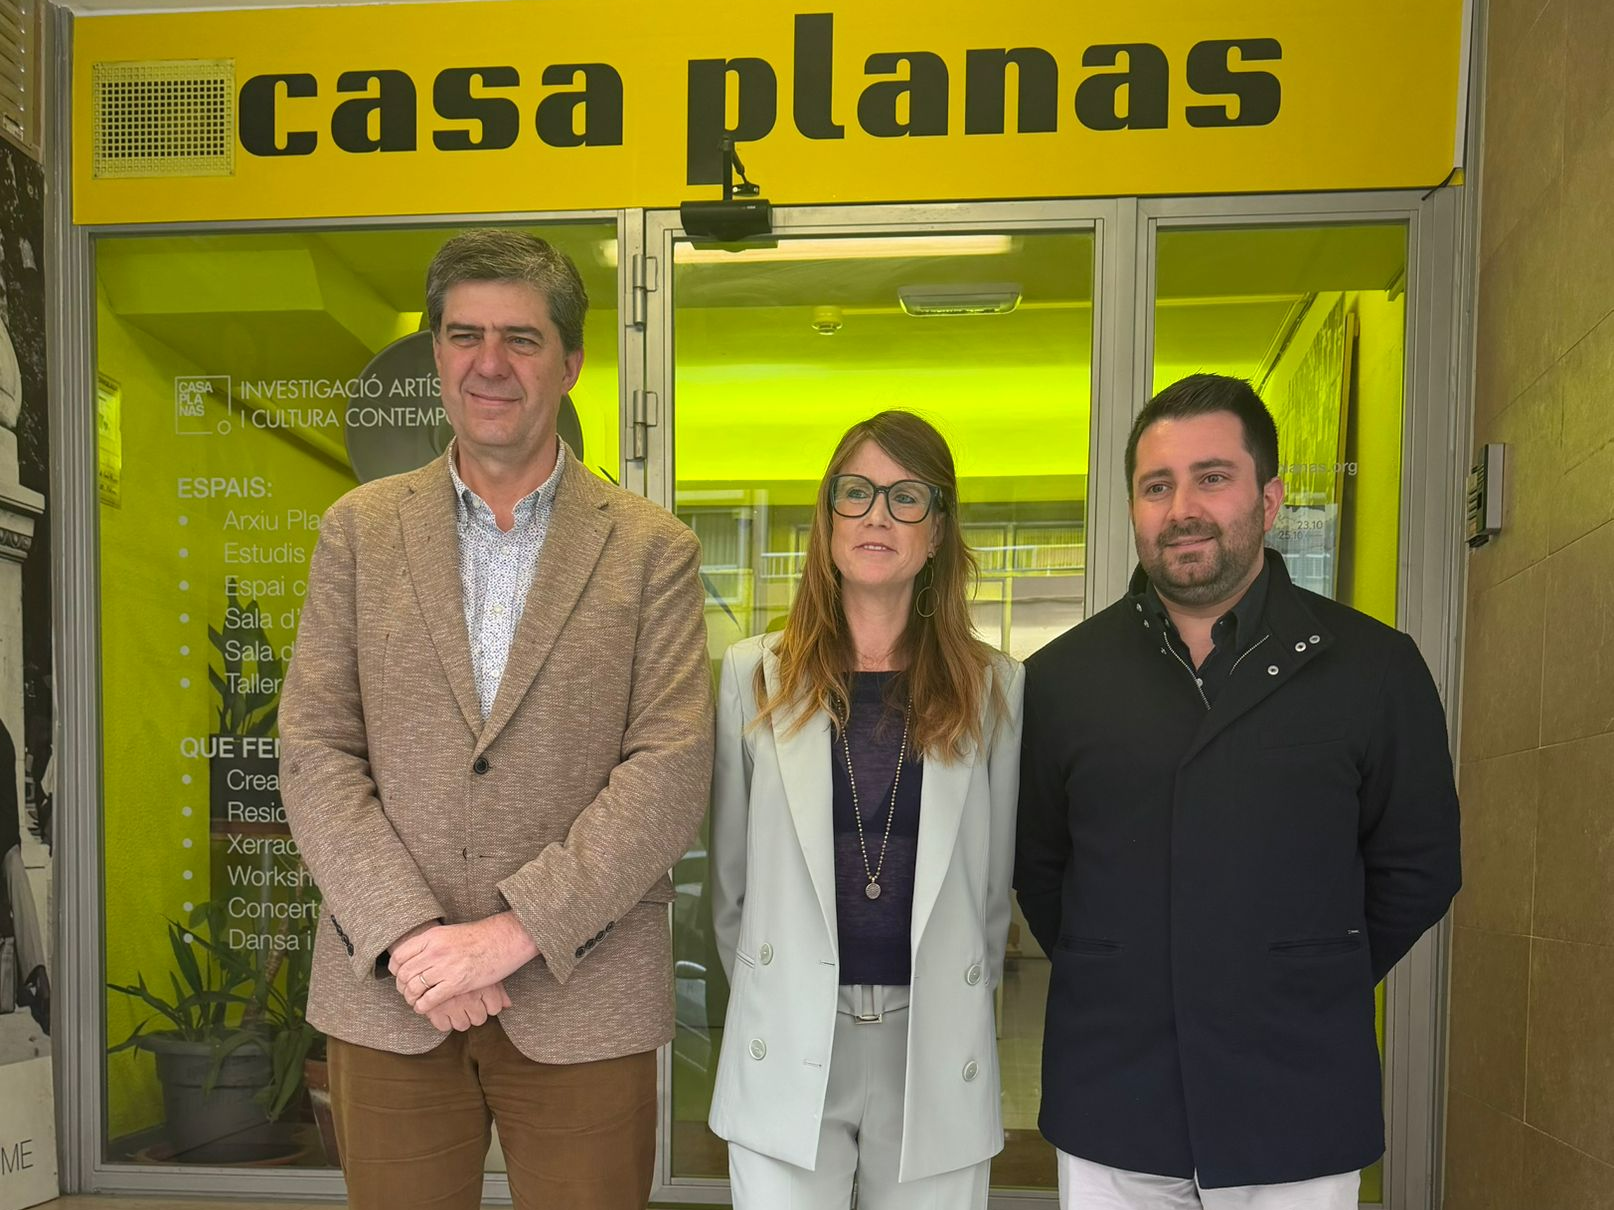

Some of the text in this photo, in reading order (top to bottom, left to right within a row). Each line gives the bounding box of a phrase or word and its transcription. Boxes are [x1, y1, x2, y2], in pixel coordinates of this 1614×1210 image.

[238, 12, 1283, 186] casa planas
[179, 381, 213, 393] CASA
[241, 372, 441, 399] INVESTIGACIÓ ARTÍS
[179, 393, 204, 405] PLA
[179, 405, 205, 416] NAS
[251, 408, 340, 429] CULTURA
[345, 407, 452, 428] CONTEMP
[177, 476, 273, 499] ESPAIS:
[223, 508, 321, 531] Arxiu Pla
[1297, 520, 1323, 531] 23.10
[224, 541, 306, 564] Estudis
[224, 575, 285, 600] Espai
[225, 607, 273, 630] Sala
[225, 640, 274, 662] Sala
[224, 672, 283, 694] Taller
[179, 737, 235, 759] QUE
[227, 768, 280, 791] Crea
[228, 896, 320, 918] Concert
[229, 928, 312, 950] Dansa i
[1, 1139, 33, 1175] ME
